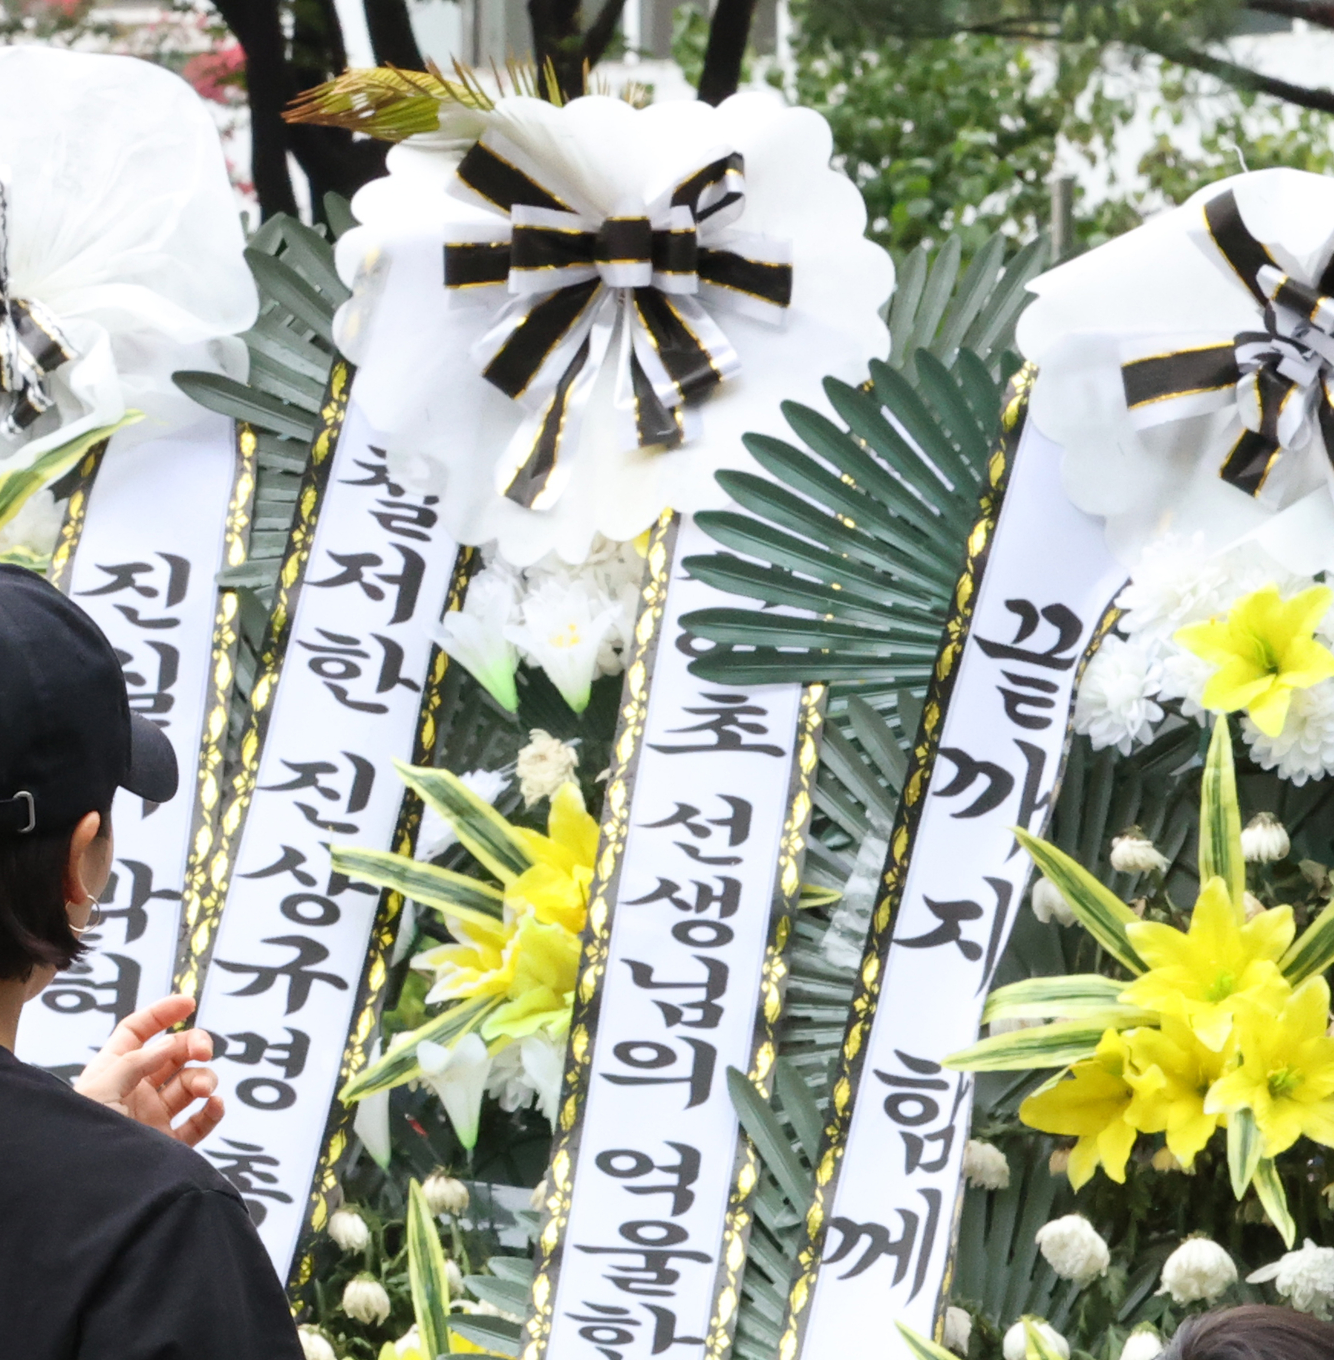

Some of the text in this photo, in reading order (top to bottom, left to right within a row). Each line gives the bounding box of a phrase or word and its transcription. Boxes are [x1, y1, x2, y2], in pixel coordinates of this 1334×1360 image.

[296, 444, 440, 715] 철저한
[200, 752, 380, 1111] 진상규명
[599, 794, 754, 1110] 선생님의
[891, 598, 1083, 997] 끝까지
[821, 1049, 970, 1309] 함께
